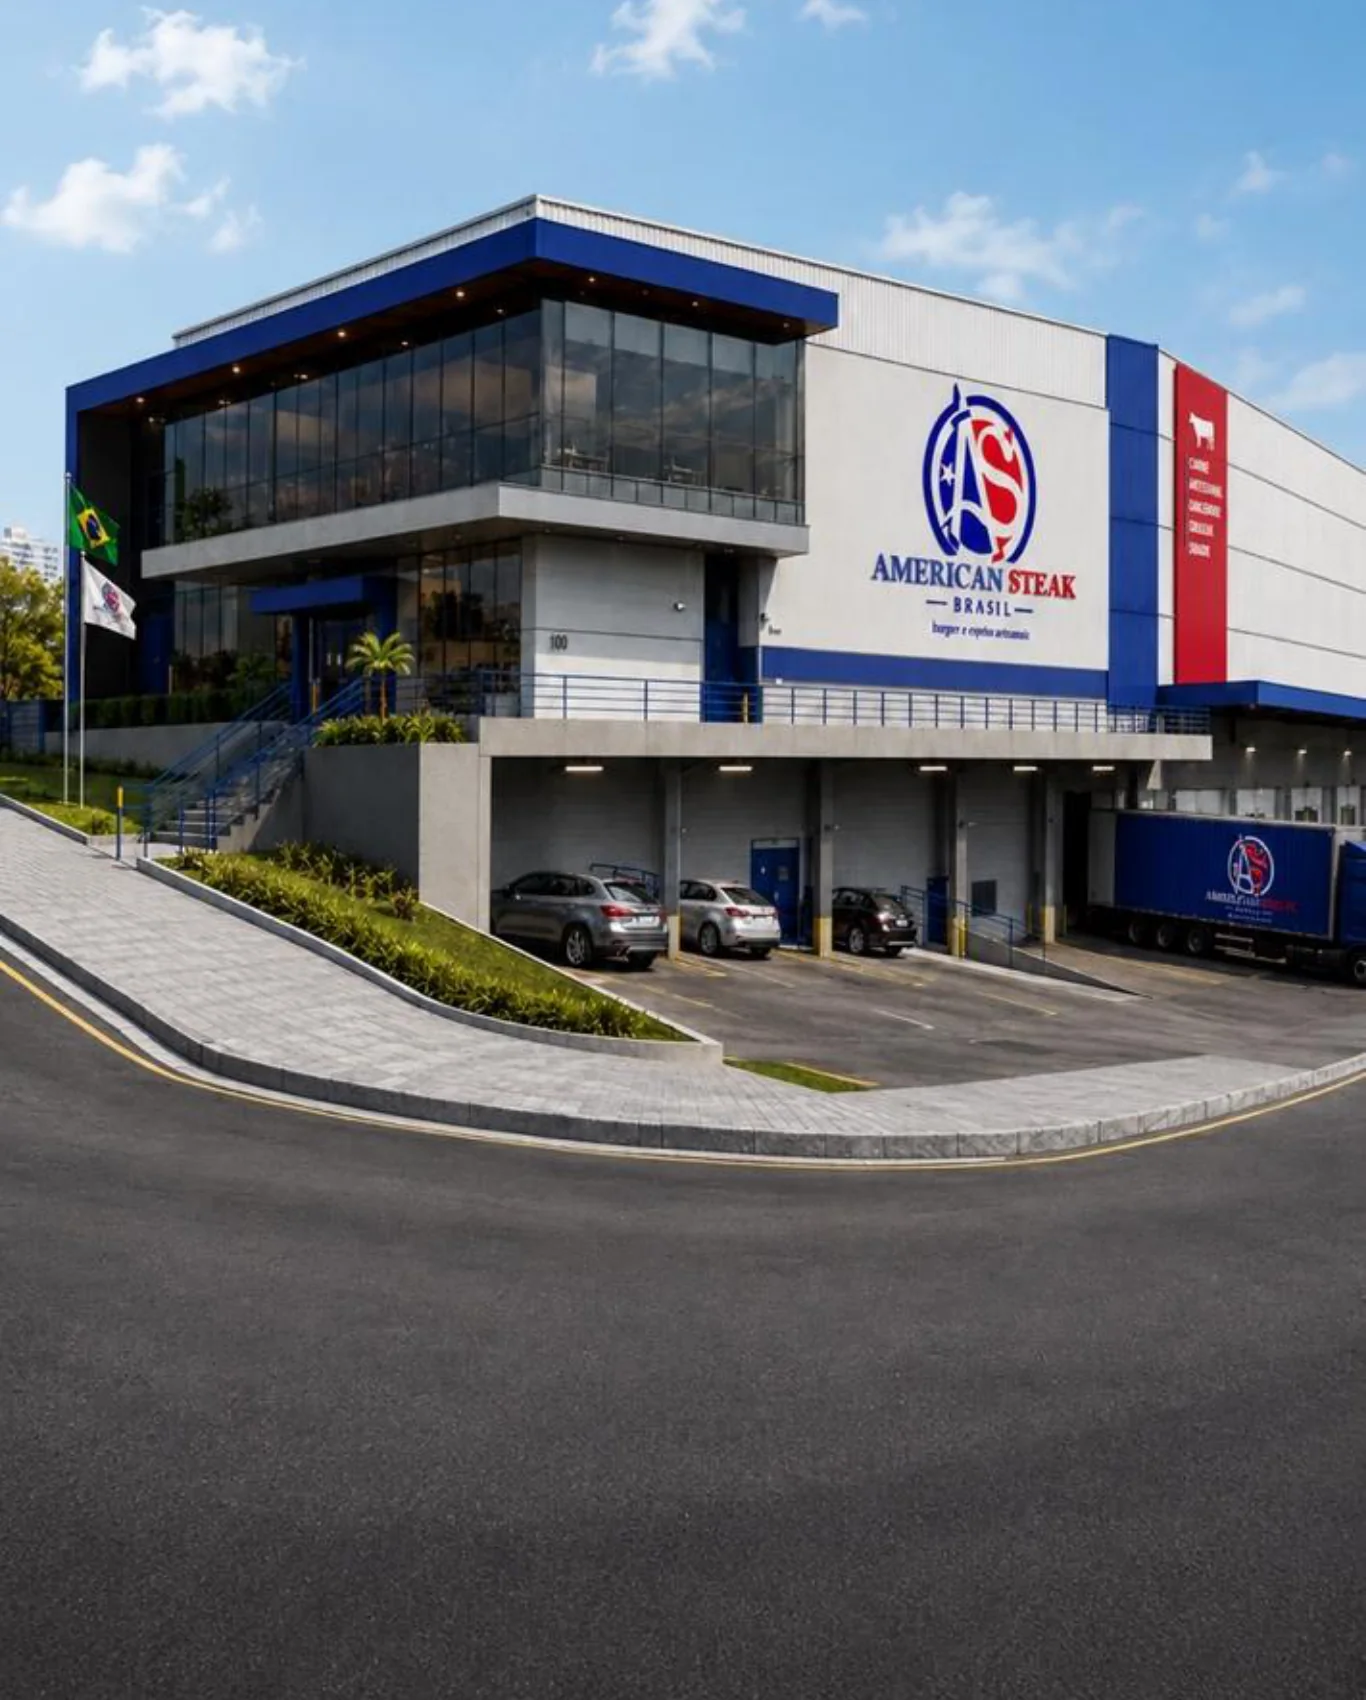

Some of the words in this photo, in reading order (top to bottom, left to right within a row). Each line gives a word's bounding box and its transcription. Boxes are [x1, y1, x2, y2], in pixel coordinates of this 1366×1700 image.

[870, 553, 1003, 593] AMERICAN
[1008, 568, 1077, 600] STEAK
[953, 596, 1011, 617] BRASIL
[551, 634, 568, 651] 100
